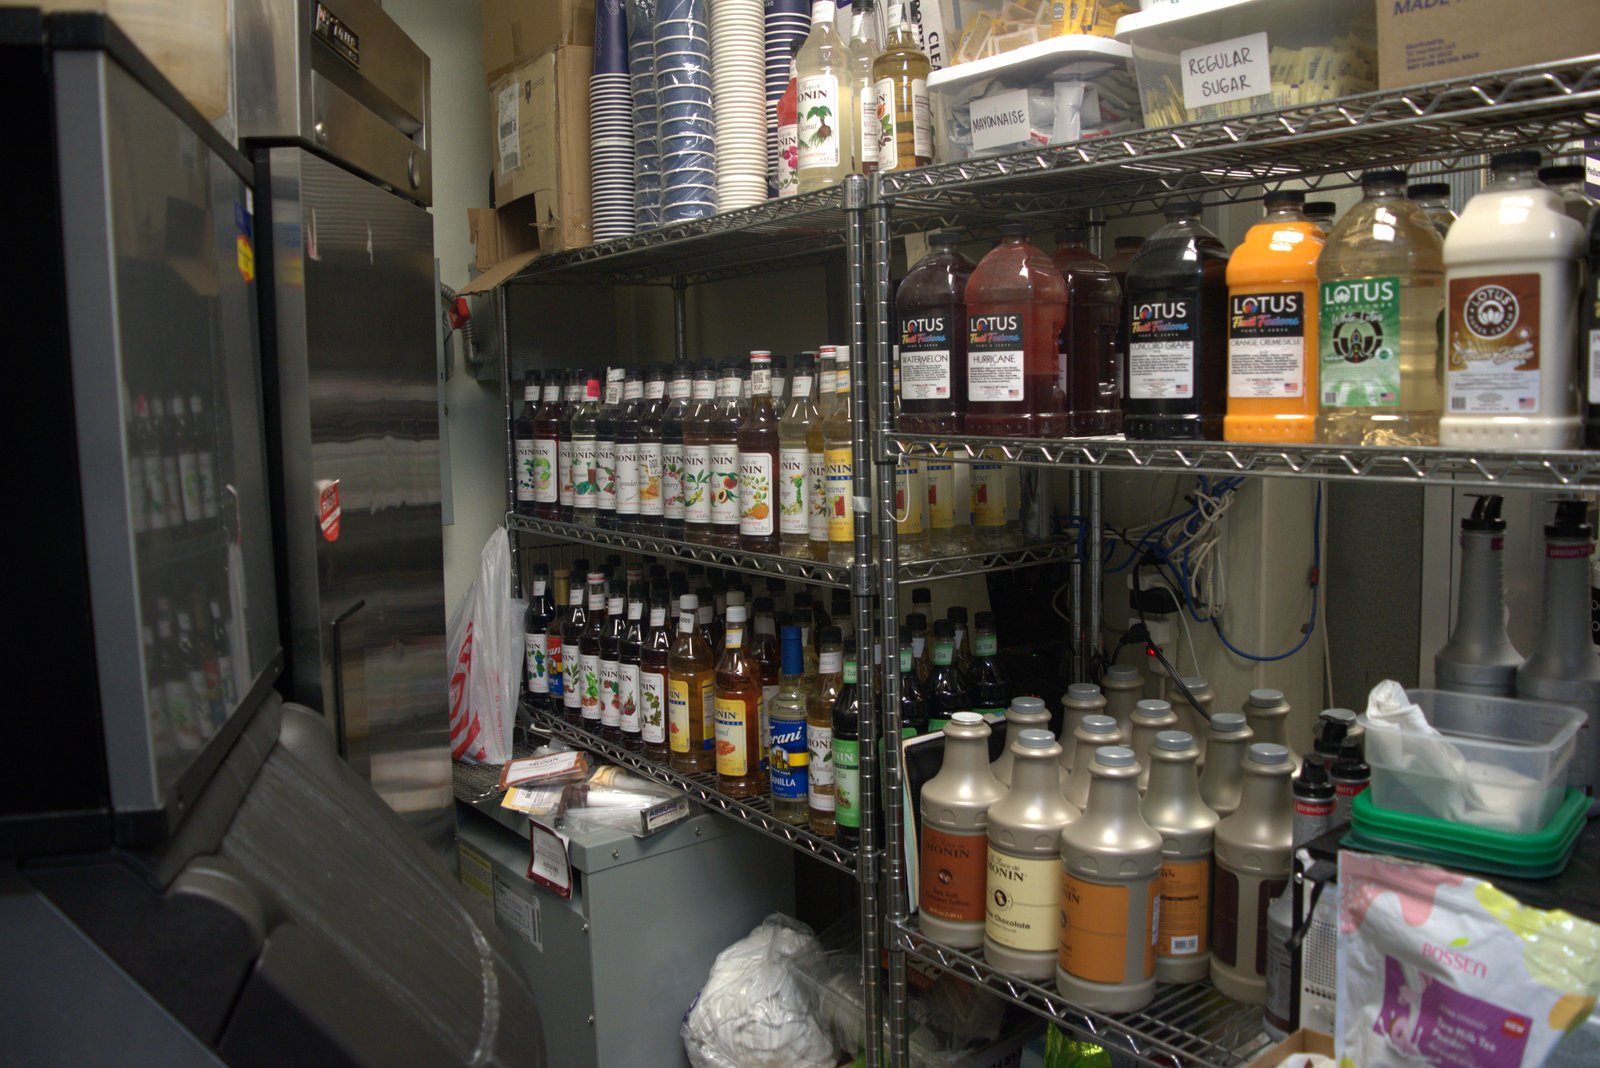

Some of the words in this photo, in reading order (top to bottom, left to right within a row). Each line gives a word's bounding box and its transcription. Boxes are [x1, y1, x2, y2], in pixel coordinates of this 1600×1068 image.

[1188, 47, 1255, 76] REGULAR
[1201, 73, 1252, 97] SUGAR
[972, 109, 1026, 134] MAYONNAISE
[1325, 282, 1394, 305] LOTUS
[1472, 287, 1513, 307] LOTUS
[1133, 302, 1187, 320] LOTUS
[1234, 296, 1298, 314] LOTUS
[902, 317, 944, 333] LOTUS
[970, 316, 1018, 332] LOTUS
[1165, 340, 1191, 349] GRAPE
[902, 354, 948, 363] WATERMELON
[973, 354, 1015, 364] HURRICANE
[926, 841, 970, 859] MONIN
[994, 914, 1031, 930] Chocolate
